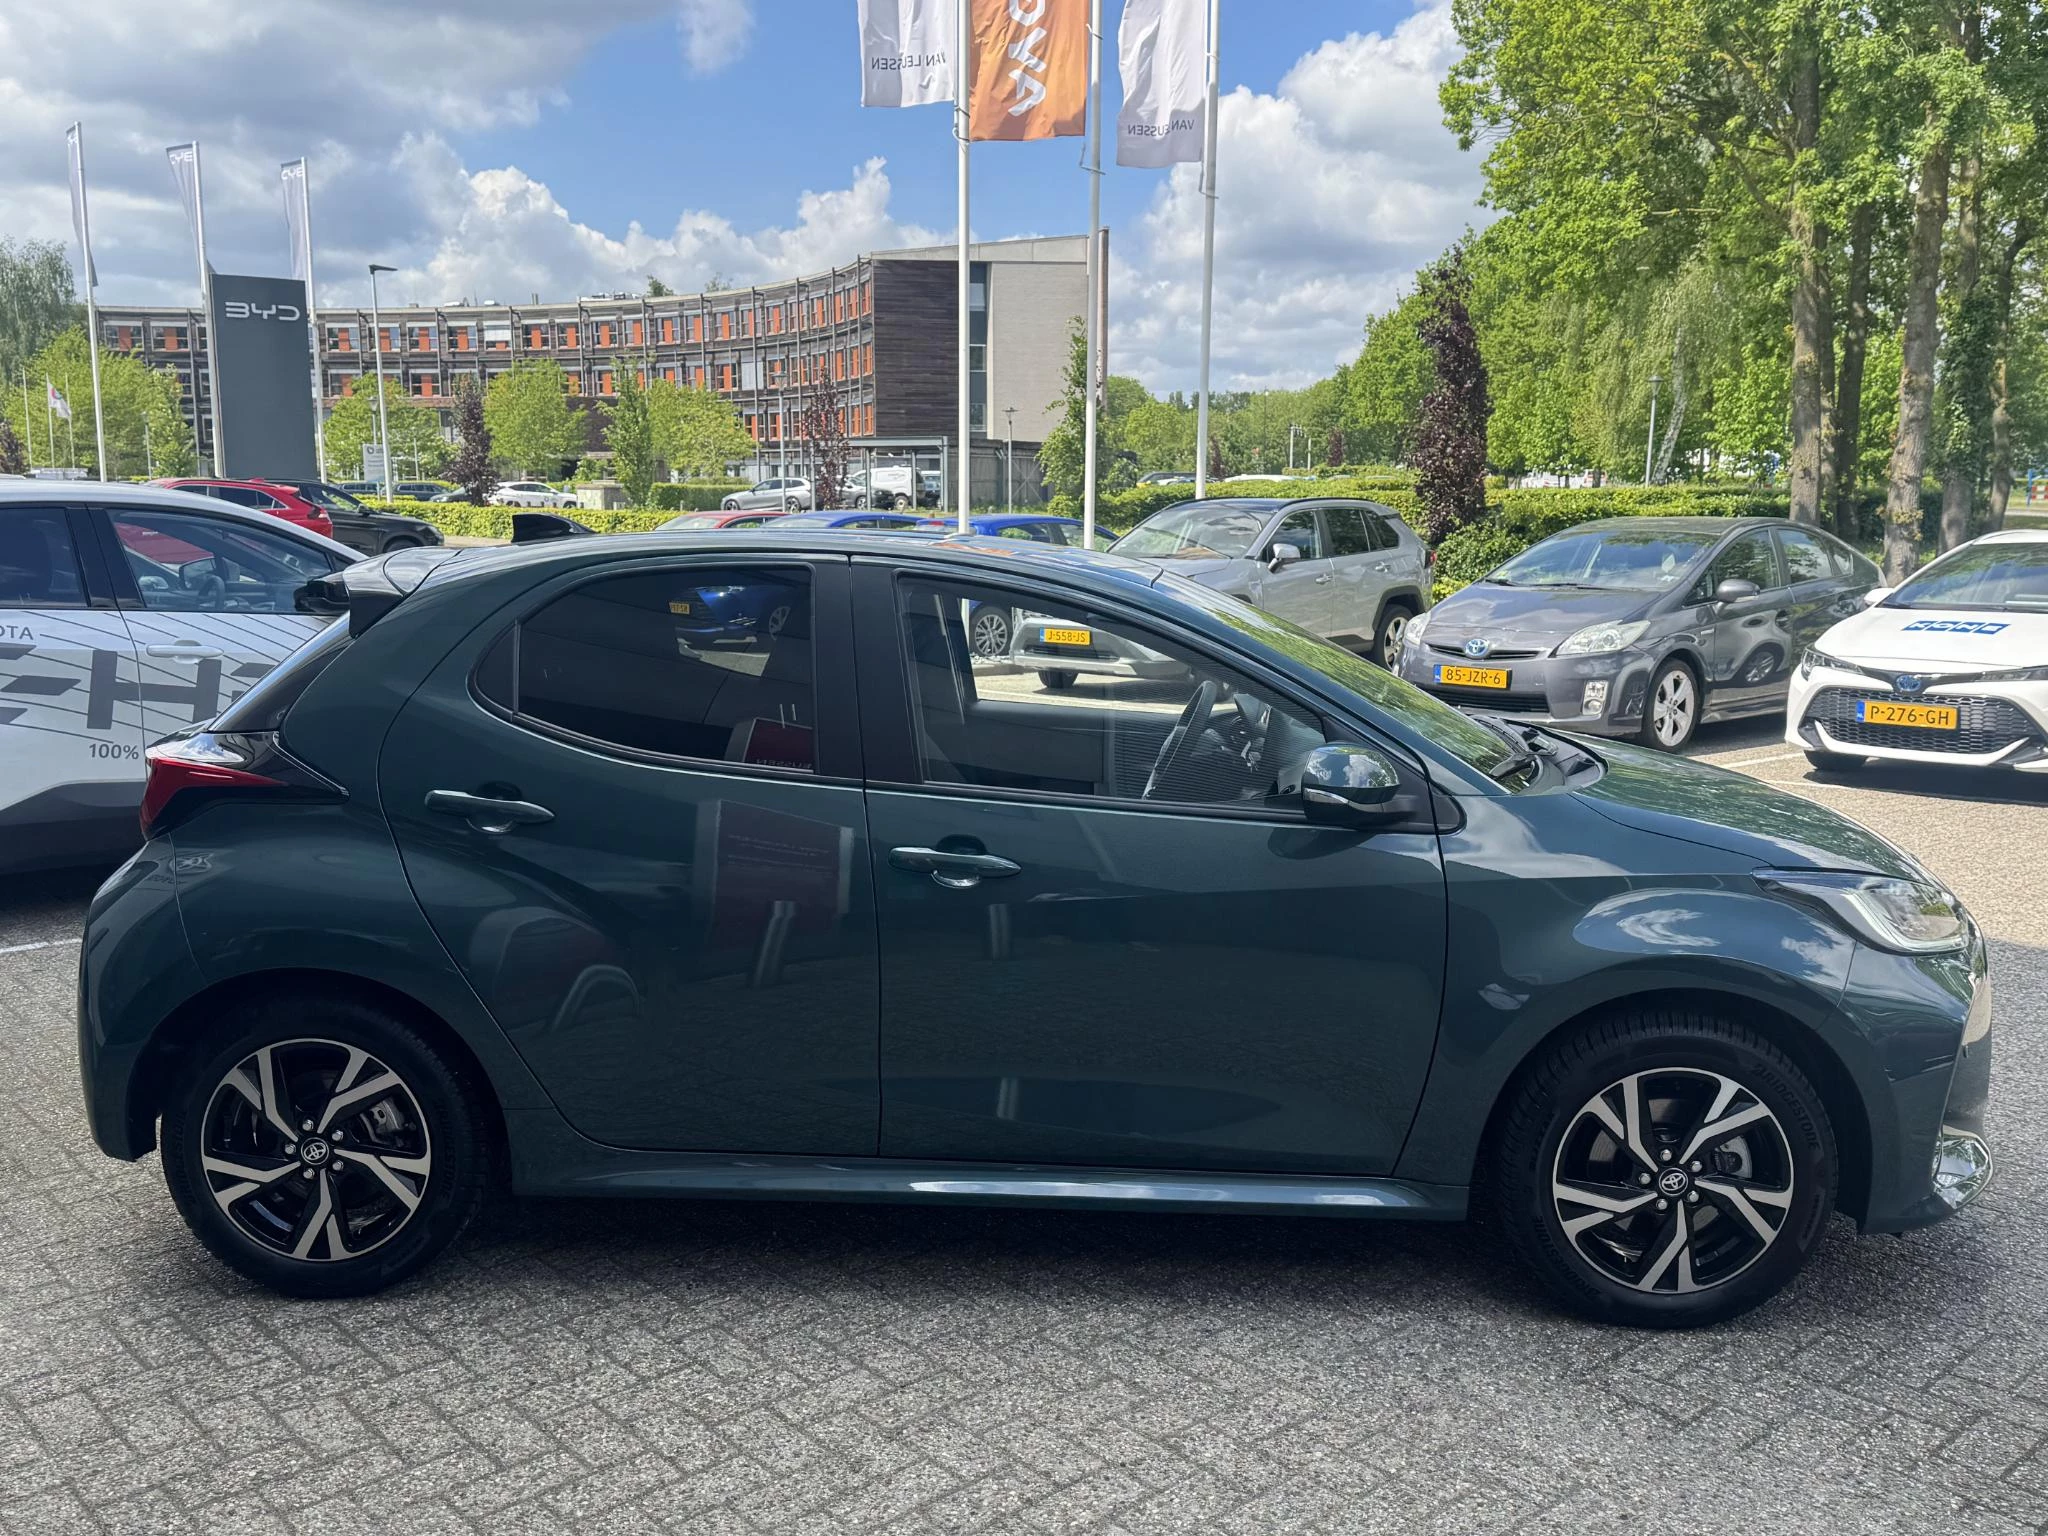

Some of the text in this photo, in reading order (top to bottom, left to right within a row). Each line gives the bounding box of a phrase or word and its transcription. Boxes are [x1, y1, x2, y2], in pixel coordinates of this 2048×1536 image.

[225, 302, 300, 321] BYD
[1048, 631, 1086, 643] J-558-JS
[1446, 668, 1501, 685] 85-JZR-6
[1870, 706, 1949, 726] P-276-GH
[88, 743, 140, 760] 100%
